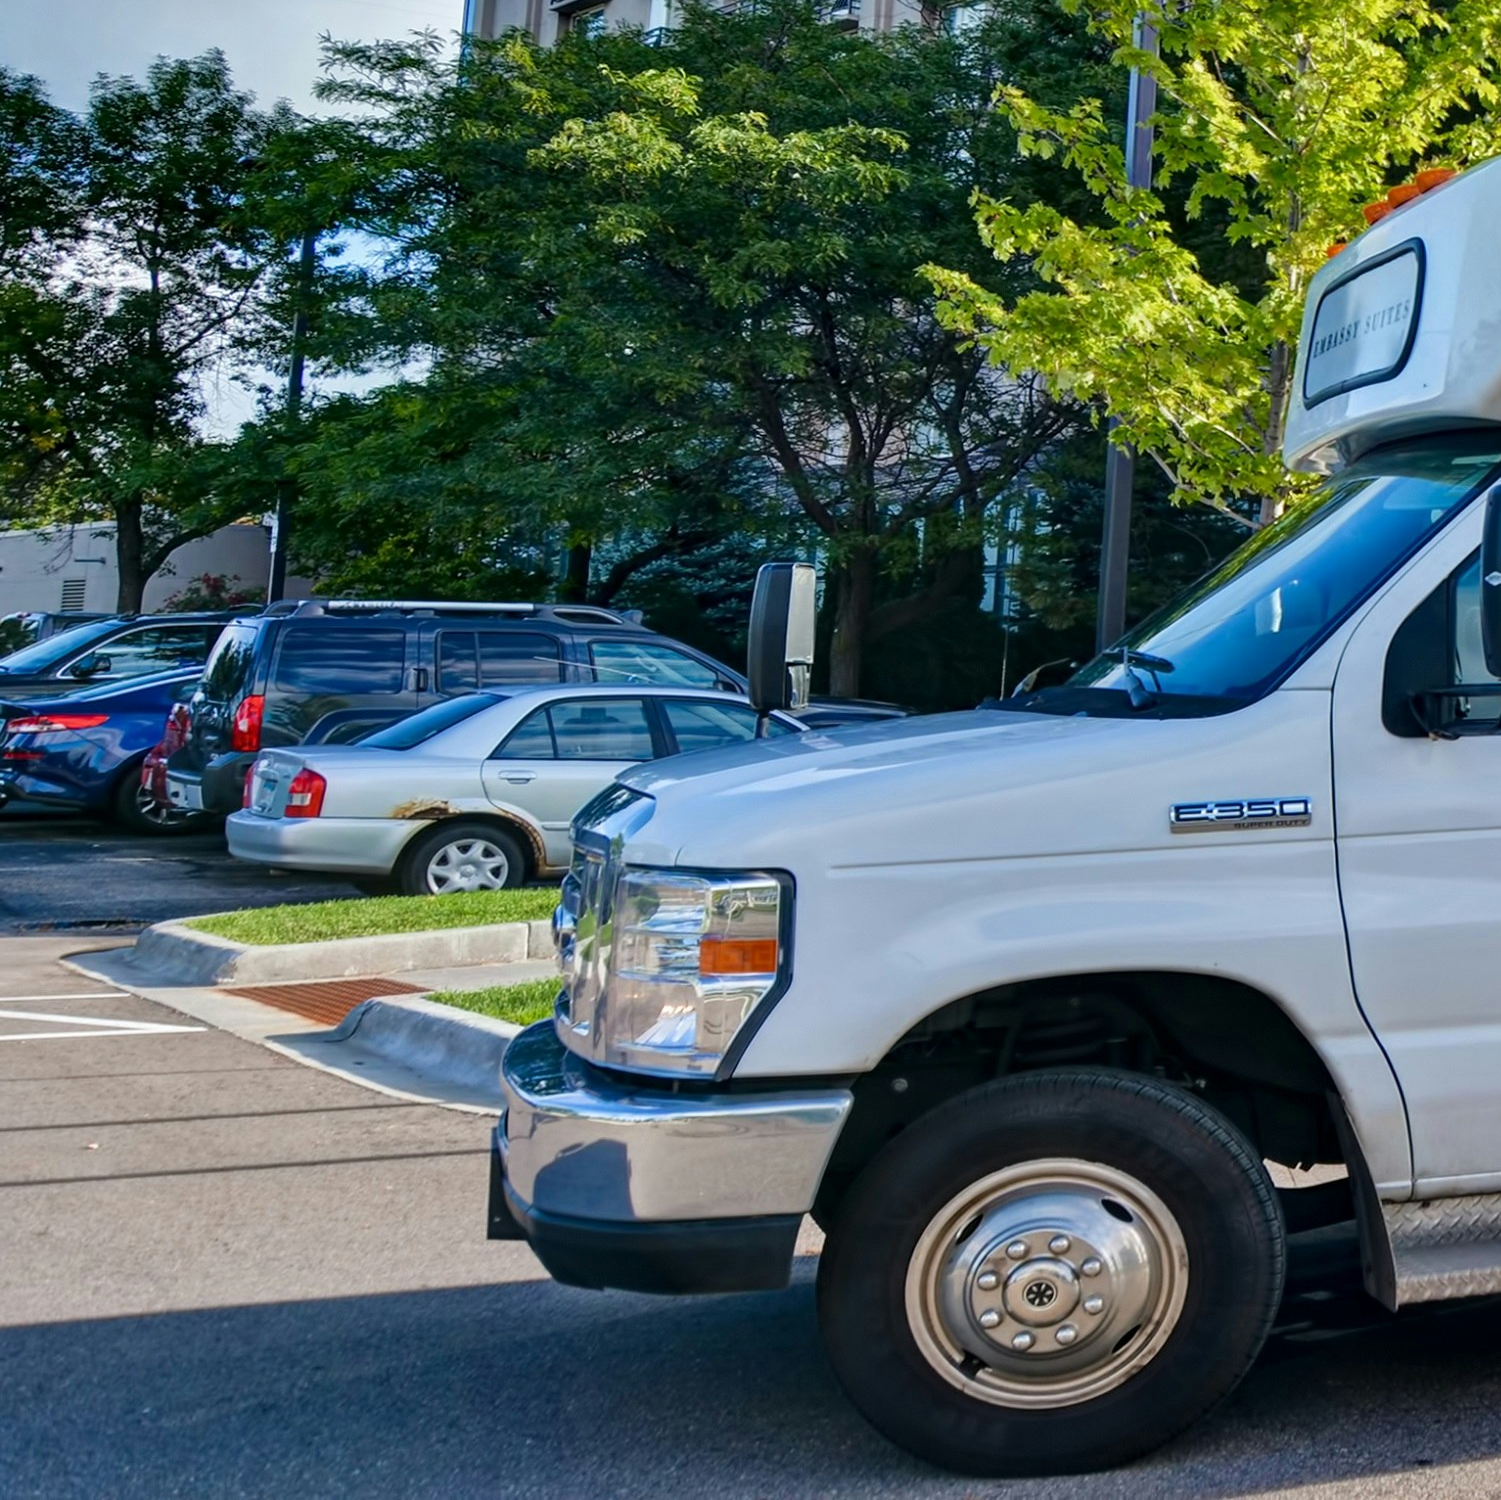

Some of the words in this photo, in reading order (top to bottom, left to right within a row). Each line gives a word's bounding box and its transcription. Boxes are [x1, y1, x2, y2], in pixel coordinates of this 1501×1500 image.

[1312, 319, 1361, 358] EMBASSY
[1363, 299, 1411, 335] SUITES
[1174, 798, 1308, 822] E-350
